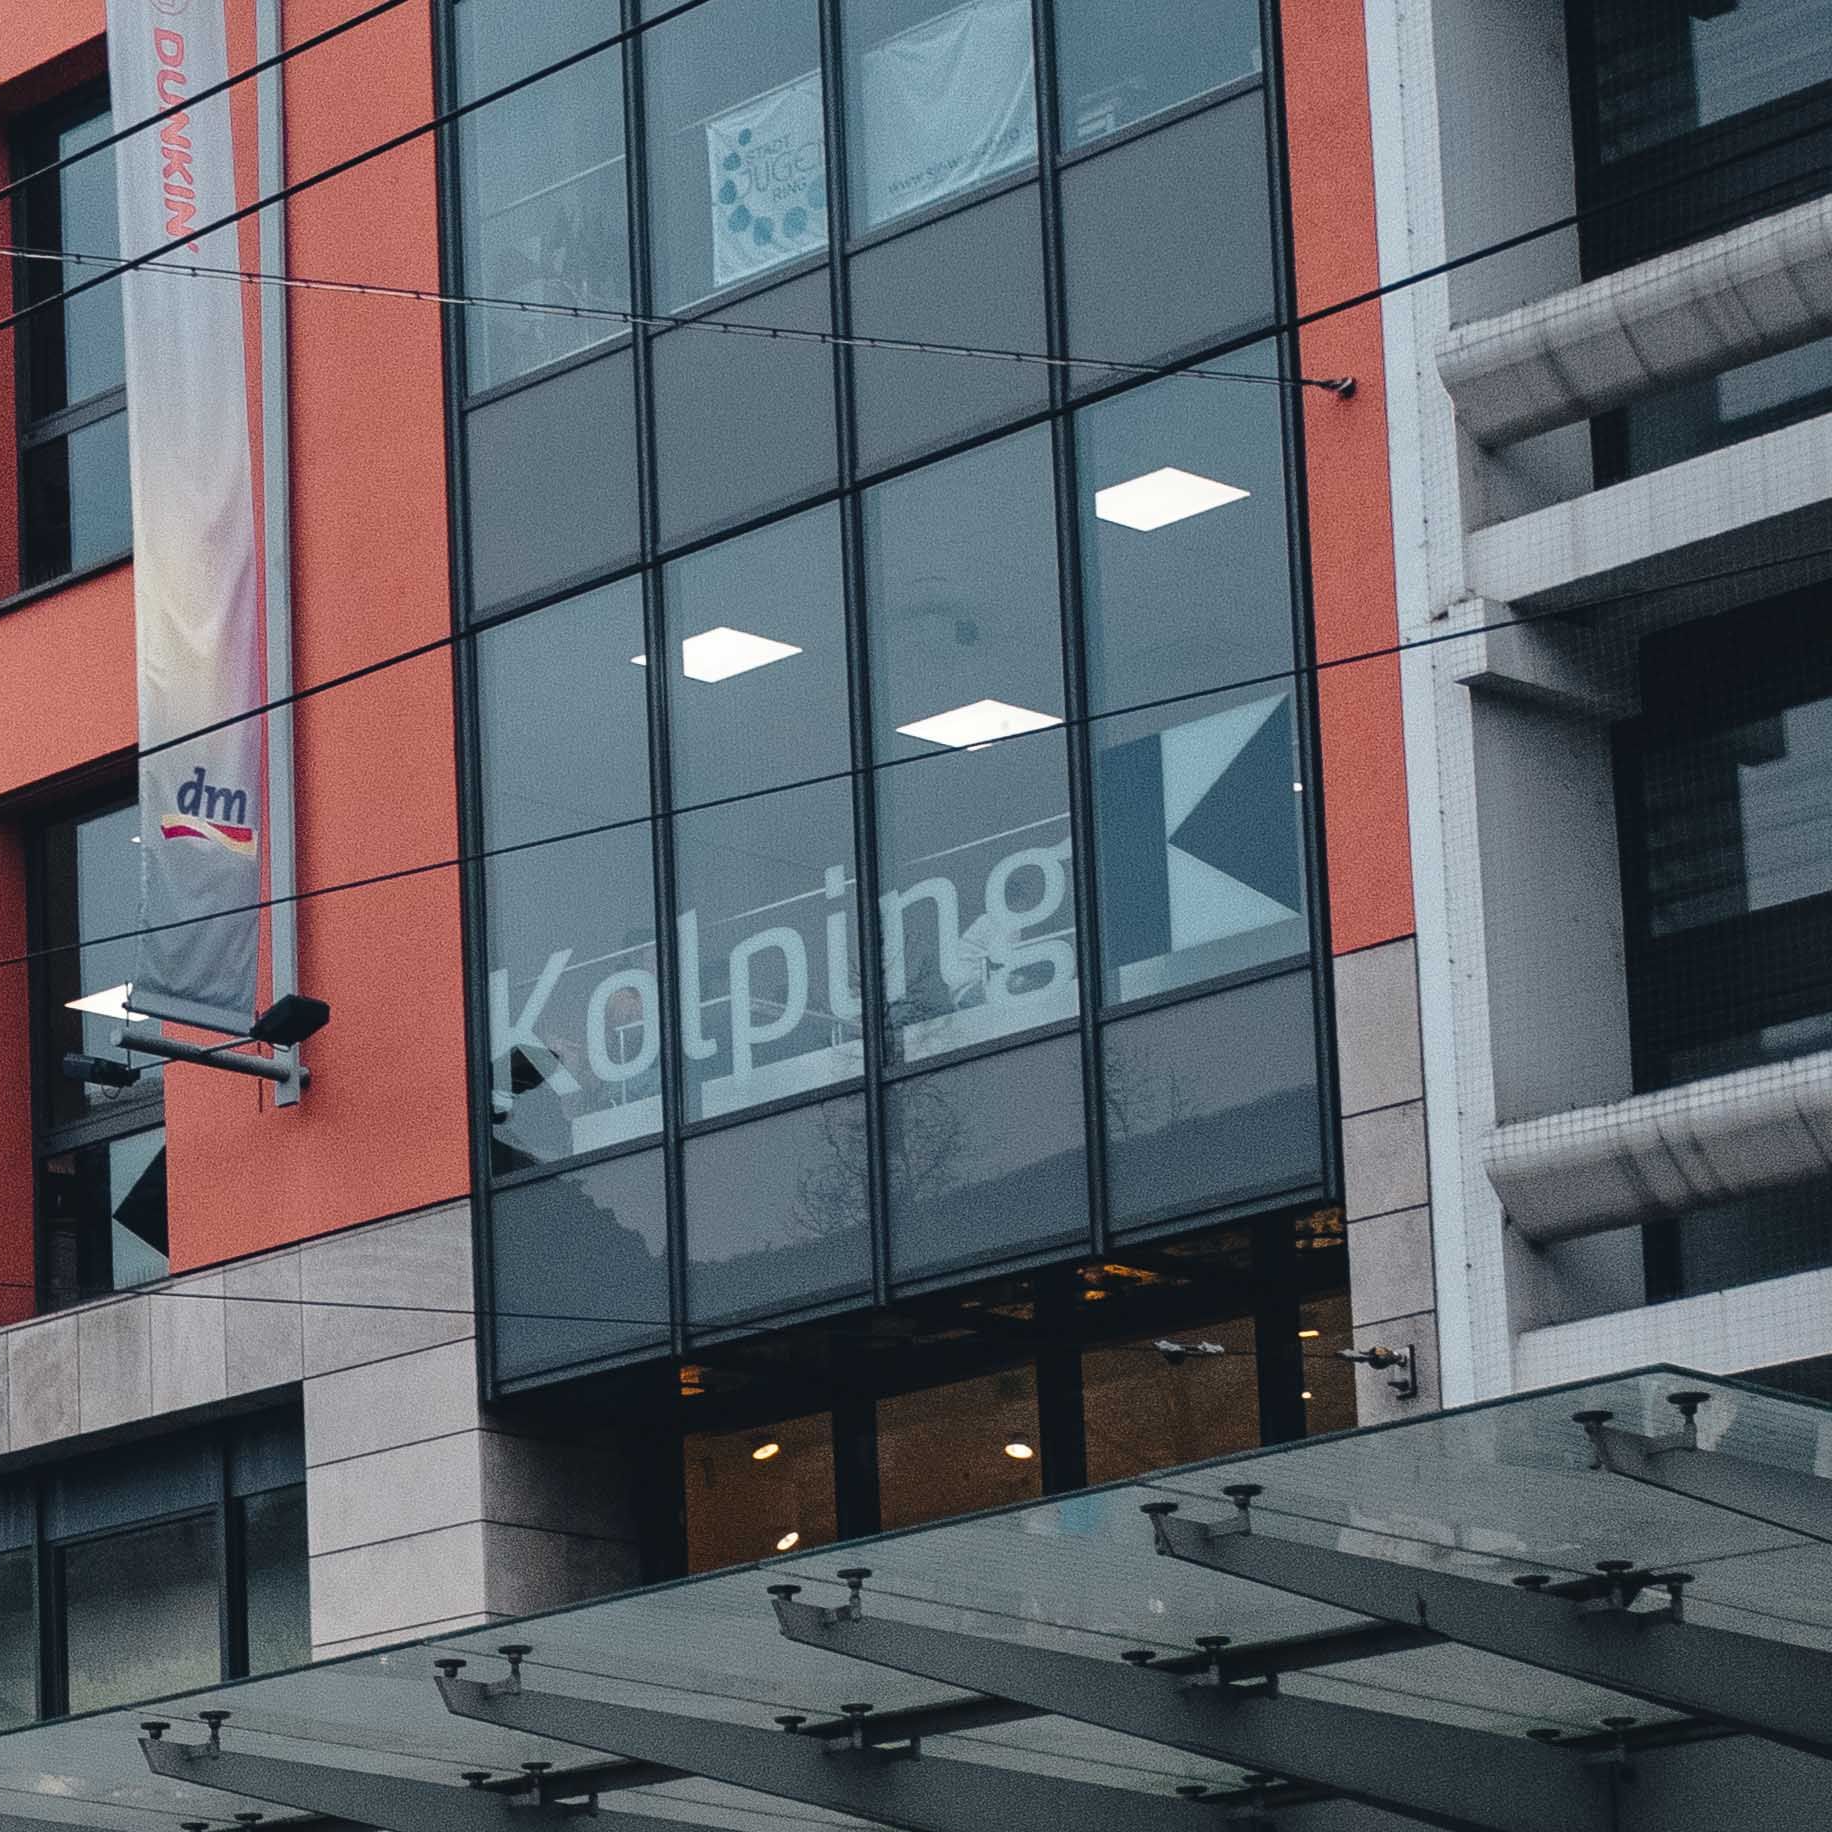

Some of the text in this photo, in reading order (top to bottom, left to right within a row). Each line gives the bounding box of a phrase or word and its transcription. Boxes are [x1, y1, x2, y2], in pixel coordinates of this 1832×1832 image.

[153, 28, 199, 253] DUNKIN'
[734, 139, 823, 200] JUGE
[177, 766, 247, 824] dm
[489, 837, 1079, 1112] Kolping
